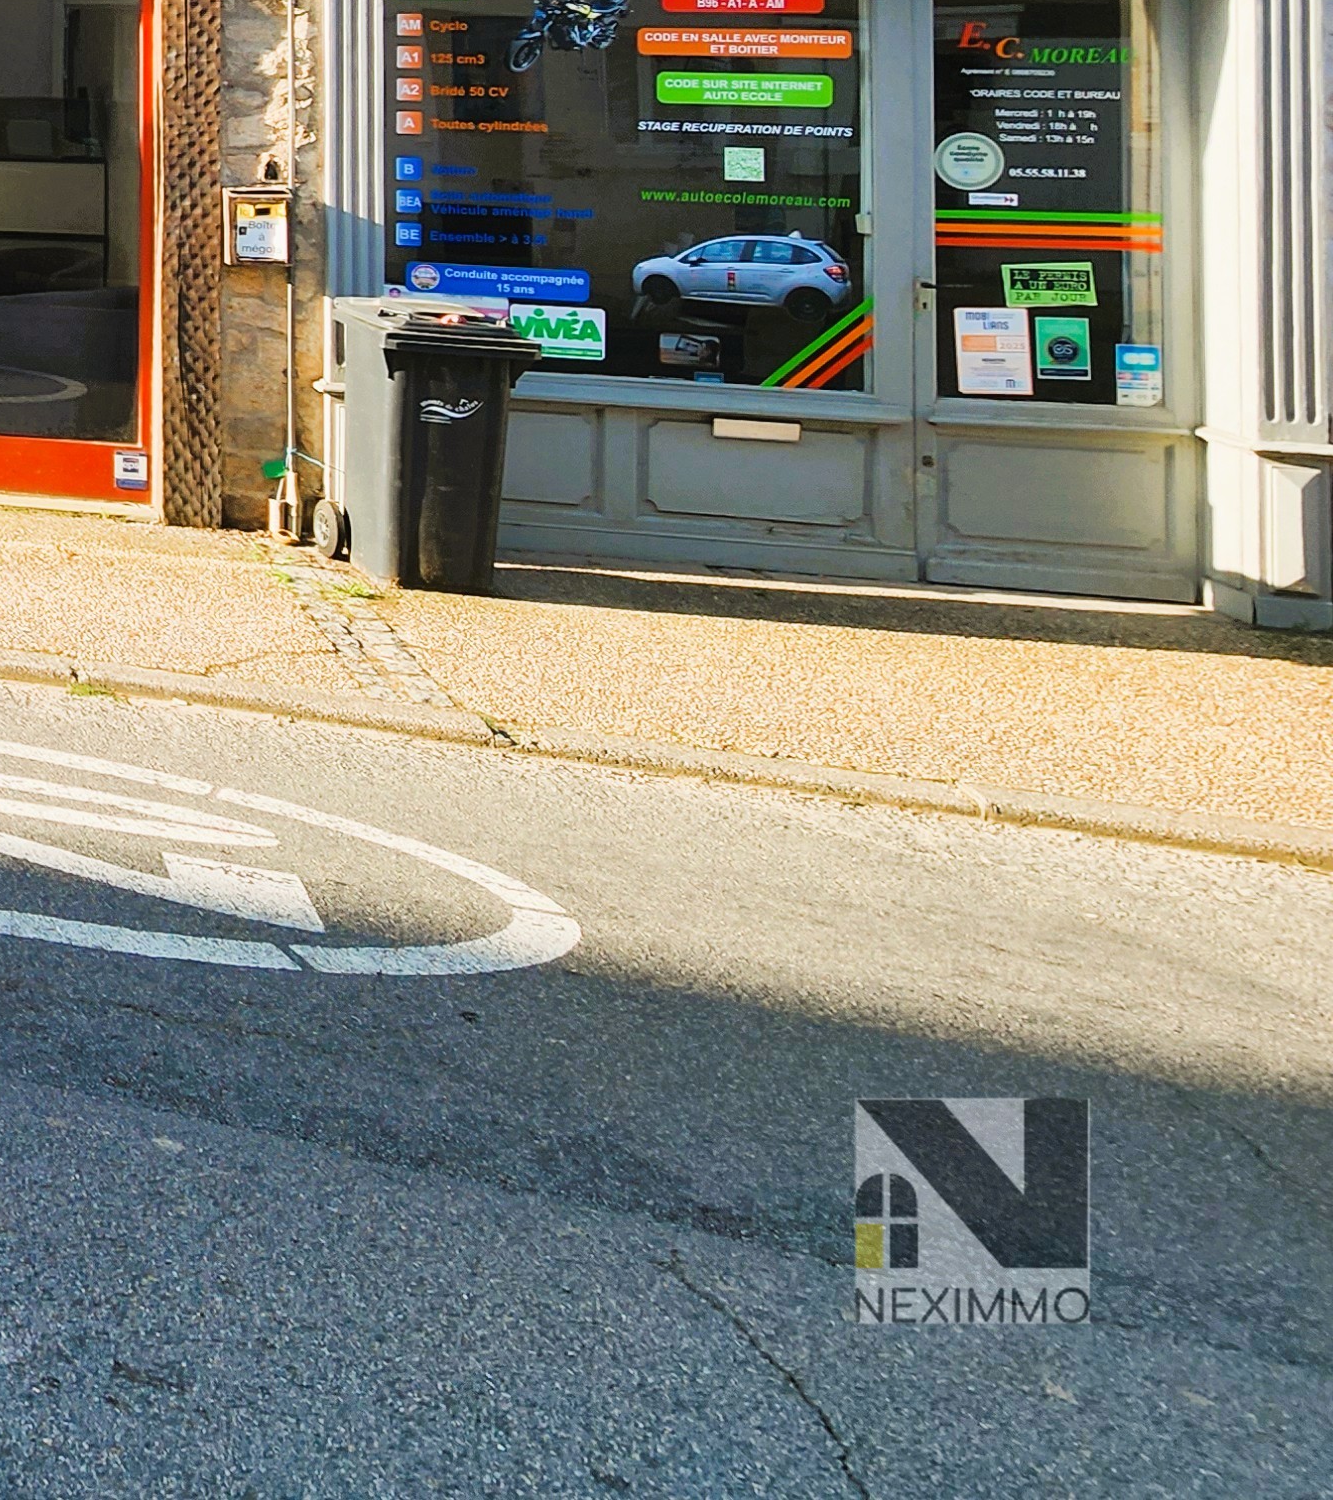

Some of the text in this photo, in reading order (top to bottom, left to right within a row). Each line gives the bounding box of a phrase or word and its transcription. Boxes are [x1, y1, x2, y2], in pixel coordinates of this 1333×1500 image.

[766, 0, 785, 9] AM
[399, 19, 468, 32] AM Cyclo
[644, 33, 846, 44] CODE EN SALLE AVEC MONITEUR
[710, 45, 779, 55] ET BOITIER
[401, 52, 485, 64] A1 125 cm3
[664, 79, 823, 91] CODE SUR SITE INTERNET
[401, 85, 420, 95] A2
[469, 86, 485, 97] 50
[488, 87, 509, 97] CV
[703, 91, 783, 101] AUTO ECOLE
[970, 89, 1121, 100] ORAIRES CODE ET BUREAU
[995, 108, 1039, 118] Mercredi
[403, 117, 549, 132] A Toutes cylindrées
[638, 121, 853, 137] STAGE RECUPERATION DE POINTS
[996, 121, 1040, 130] Vendredi
[998, 133, 1037, 142] Samedi
[403, 163, 415, 174] B
[399, 196, 422, 207] BEA
[640, 190, 851, 208] www.autoecolemoreau.com
[430, 204, 488, 216] Véhicule
[399, 229, 420, 240] BE
[429, 230, 495, 243] Ensemble
[444, 268, 585, 286] Conduite accompagnée
[1013, 270, 1088, 282] LE PERMIS
[496, 283, 535, 295] 15 ans
[1013, 281, 1088, 291] A UN EURO
[999, 342, 1026, 350] 2025
